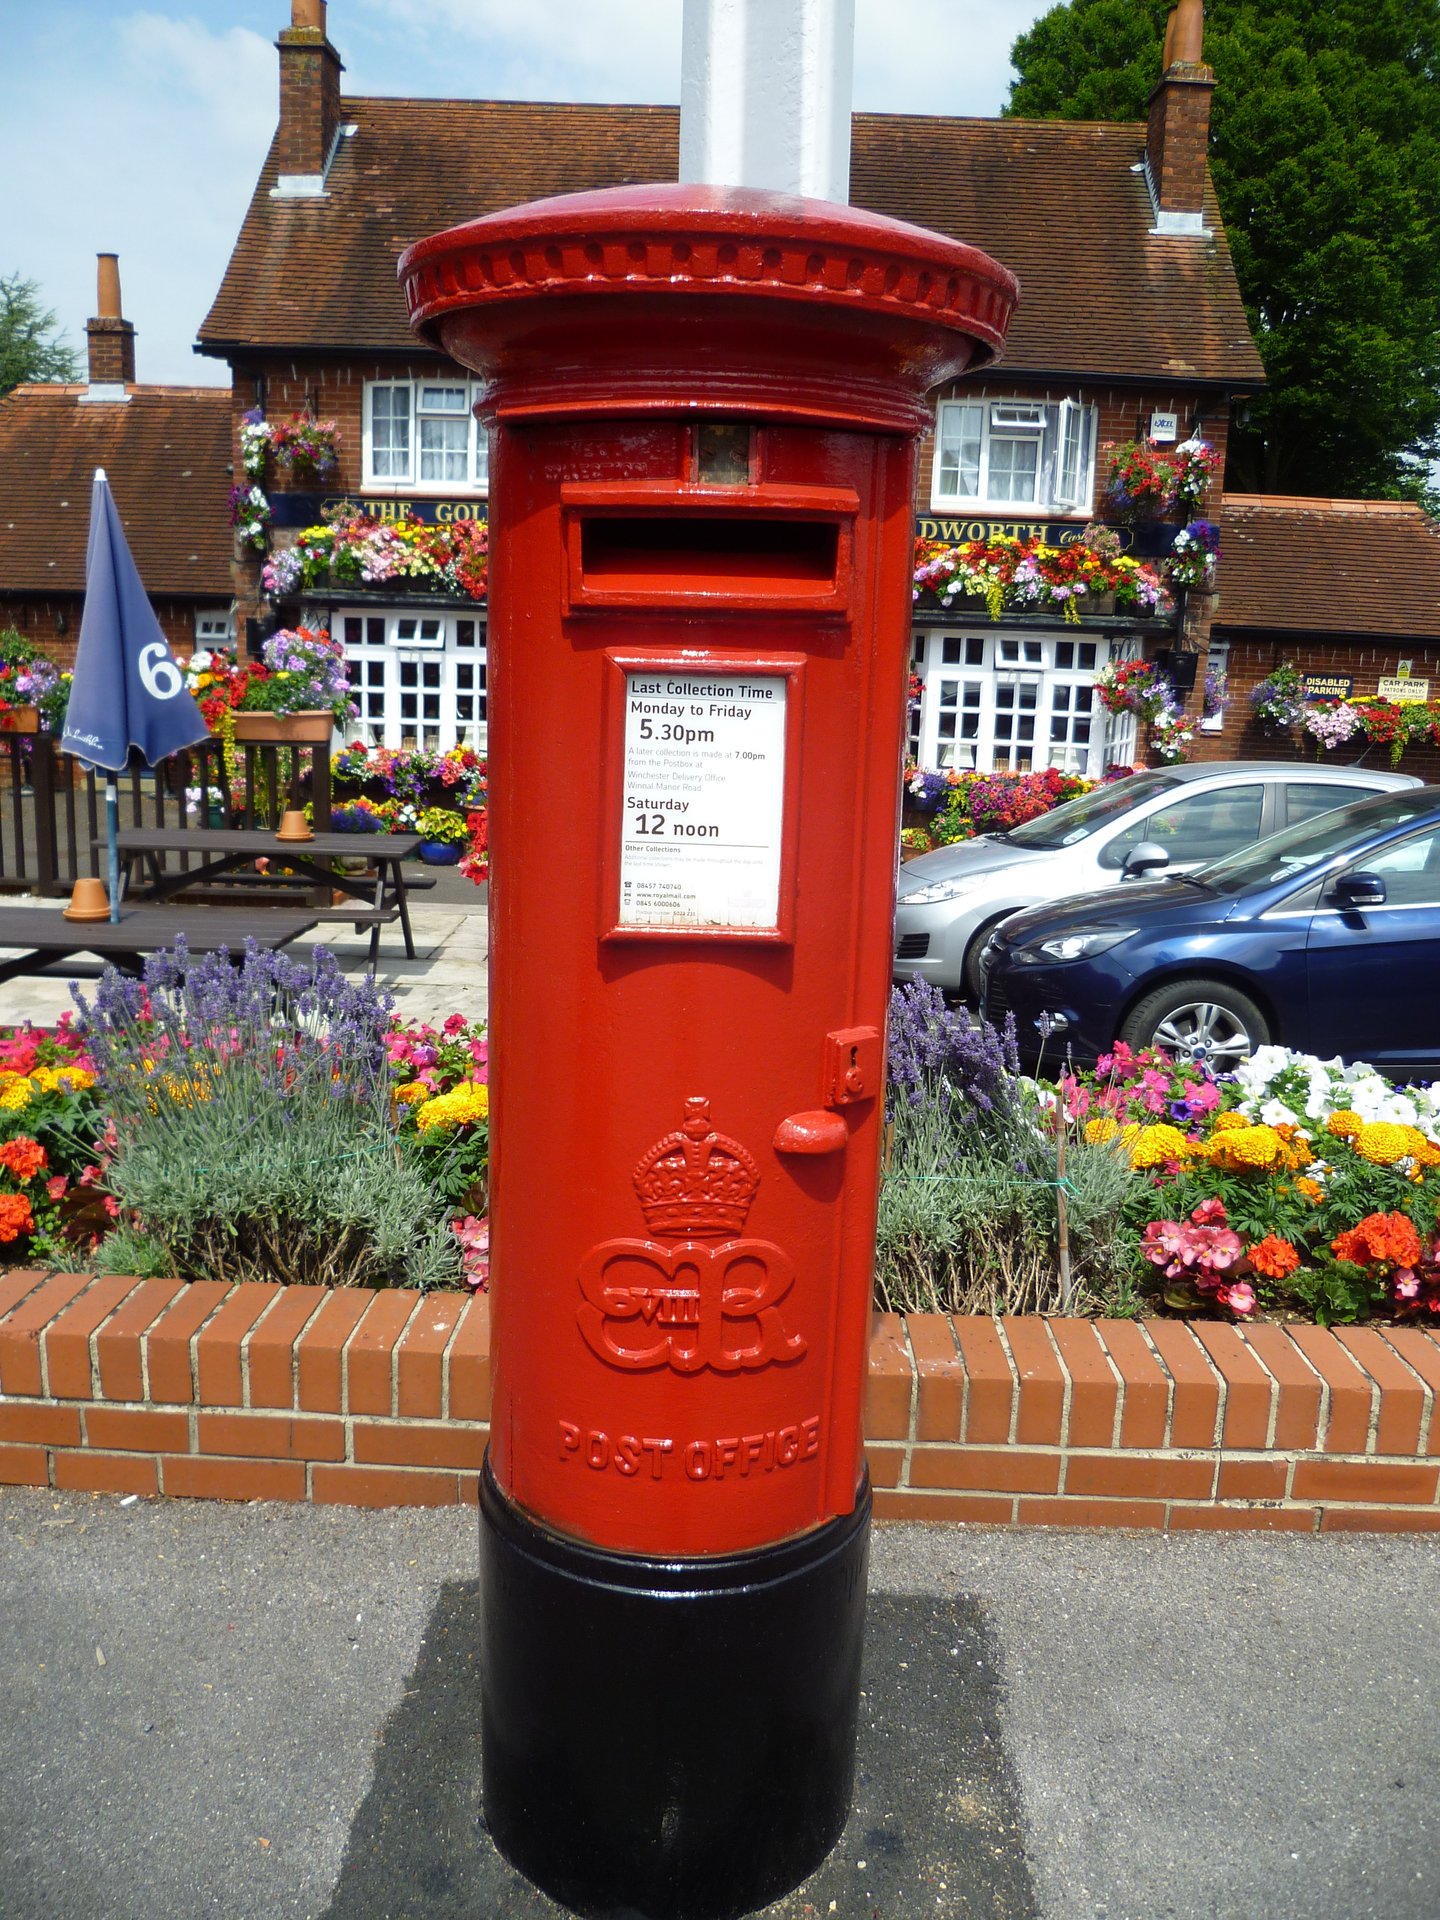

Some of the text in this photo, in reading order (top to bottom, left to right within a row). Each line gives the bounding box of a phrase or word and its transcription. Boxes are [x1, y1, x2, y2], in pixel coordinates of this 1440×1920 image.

[364, 502, 411, 521] THE
[435, 504, 488, 523] GOL
[919, 521, 1048, 544] DWORTH
[1306, 677, 1350, 687] DISABLED
[631, 681, 773, 699] Last Collection Time
[1308, 687, 1346, 695] PARKING
[631, 702, 752, 720] Monday to Friday
[640, 719, 714, 744] 5.30pm
[637, 748, 653, 756] later
[656, 749, 690, 757] collection
[735, 752, 765, 761] 7.00pm
[628, 758, 646, 766] from
[649, 759, 661, 767] the
[664, 760, 692, 768] Postbox
[628, 771, 726, 782] Winchester Delivery Office
[656, 783, 679, 791] Manor
[682, 784, 702, 792] Road
[627, 797, 689, 812] Saturday
[635, 814, 719, 838] 12 noon
[559, 1415, 820, 1481] POST OFFICE
